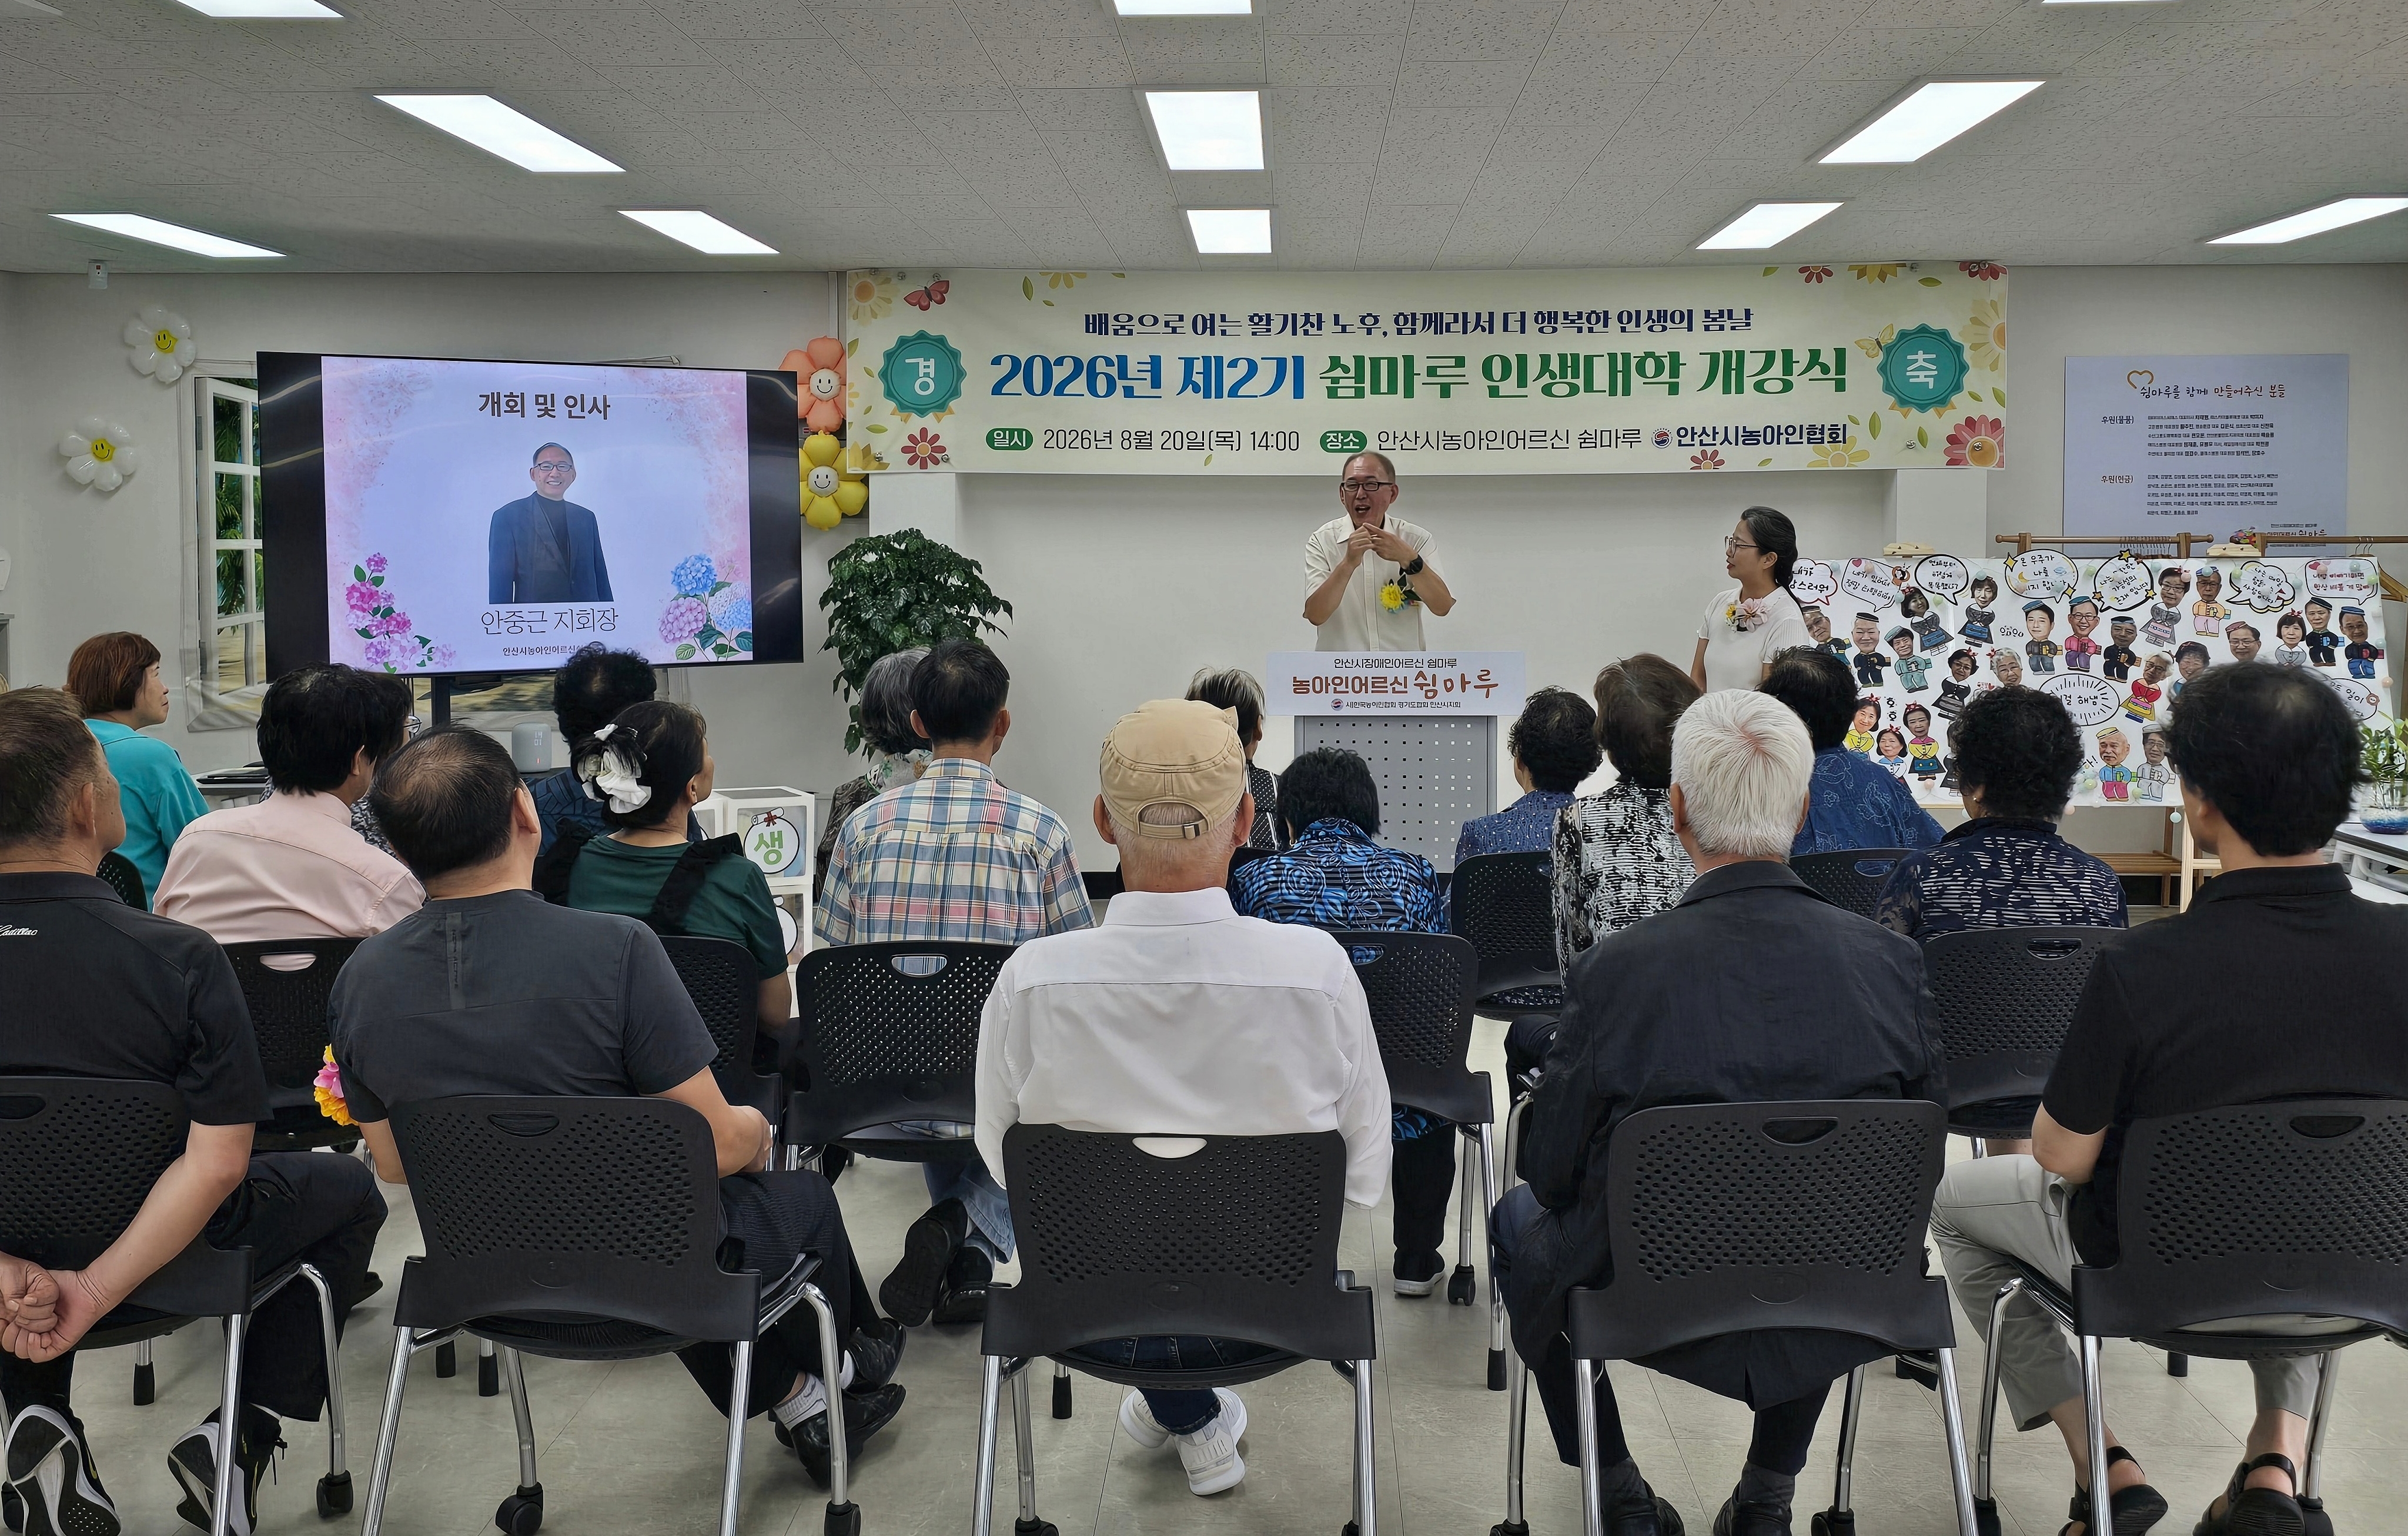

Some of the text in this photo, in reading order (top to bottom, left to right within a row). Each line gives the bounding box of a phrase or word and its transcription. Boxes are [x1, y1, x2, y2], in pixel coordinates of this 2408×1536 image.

[1084, 308, 1754, 337] 배움으로 여는 활기찬 노후, 함께라서 더 행복한 인생의 봄날
[904, 358, 935, 396] 경
[991, 347, 1847, 400] 2026년 제2기 쉼마루 인생대학 개강식
[1905, 352, 1935, 389] 축
[2214, 384, 2263, 399] 만들어주신
[2269, 384, 2286, 399] 분들
[479, 392, 611, 421] 개회 및 인사
[993, 429, 1300, 451] 일시 2026년 8월 20일(목) 14:00
[1326, 429, 1641, 451] 장소 안산시농아인어르신 쉼마루
[1676, 424, 1847, 447] 안산시농아인협회
[2031, 555, 2055, 564] 우주가
[481, 608, 619, 635] 안중근 지회장
[1293, 669, 1499, 699] 농아인어르신 쉼마루
[754, 831, 783, 865] 생
